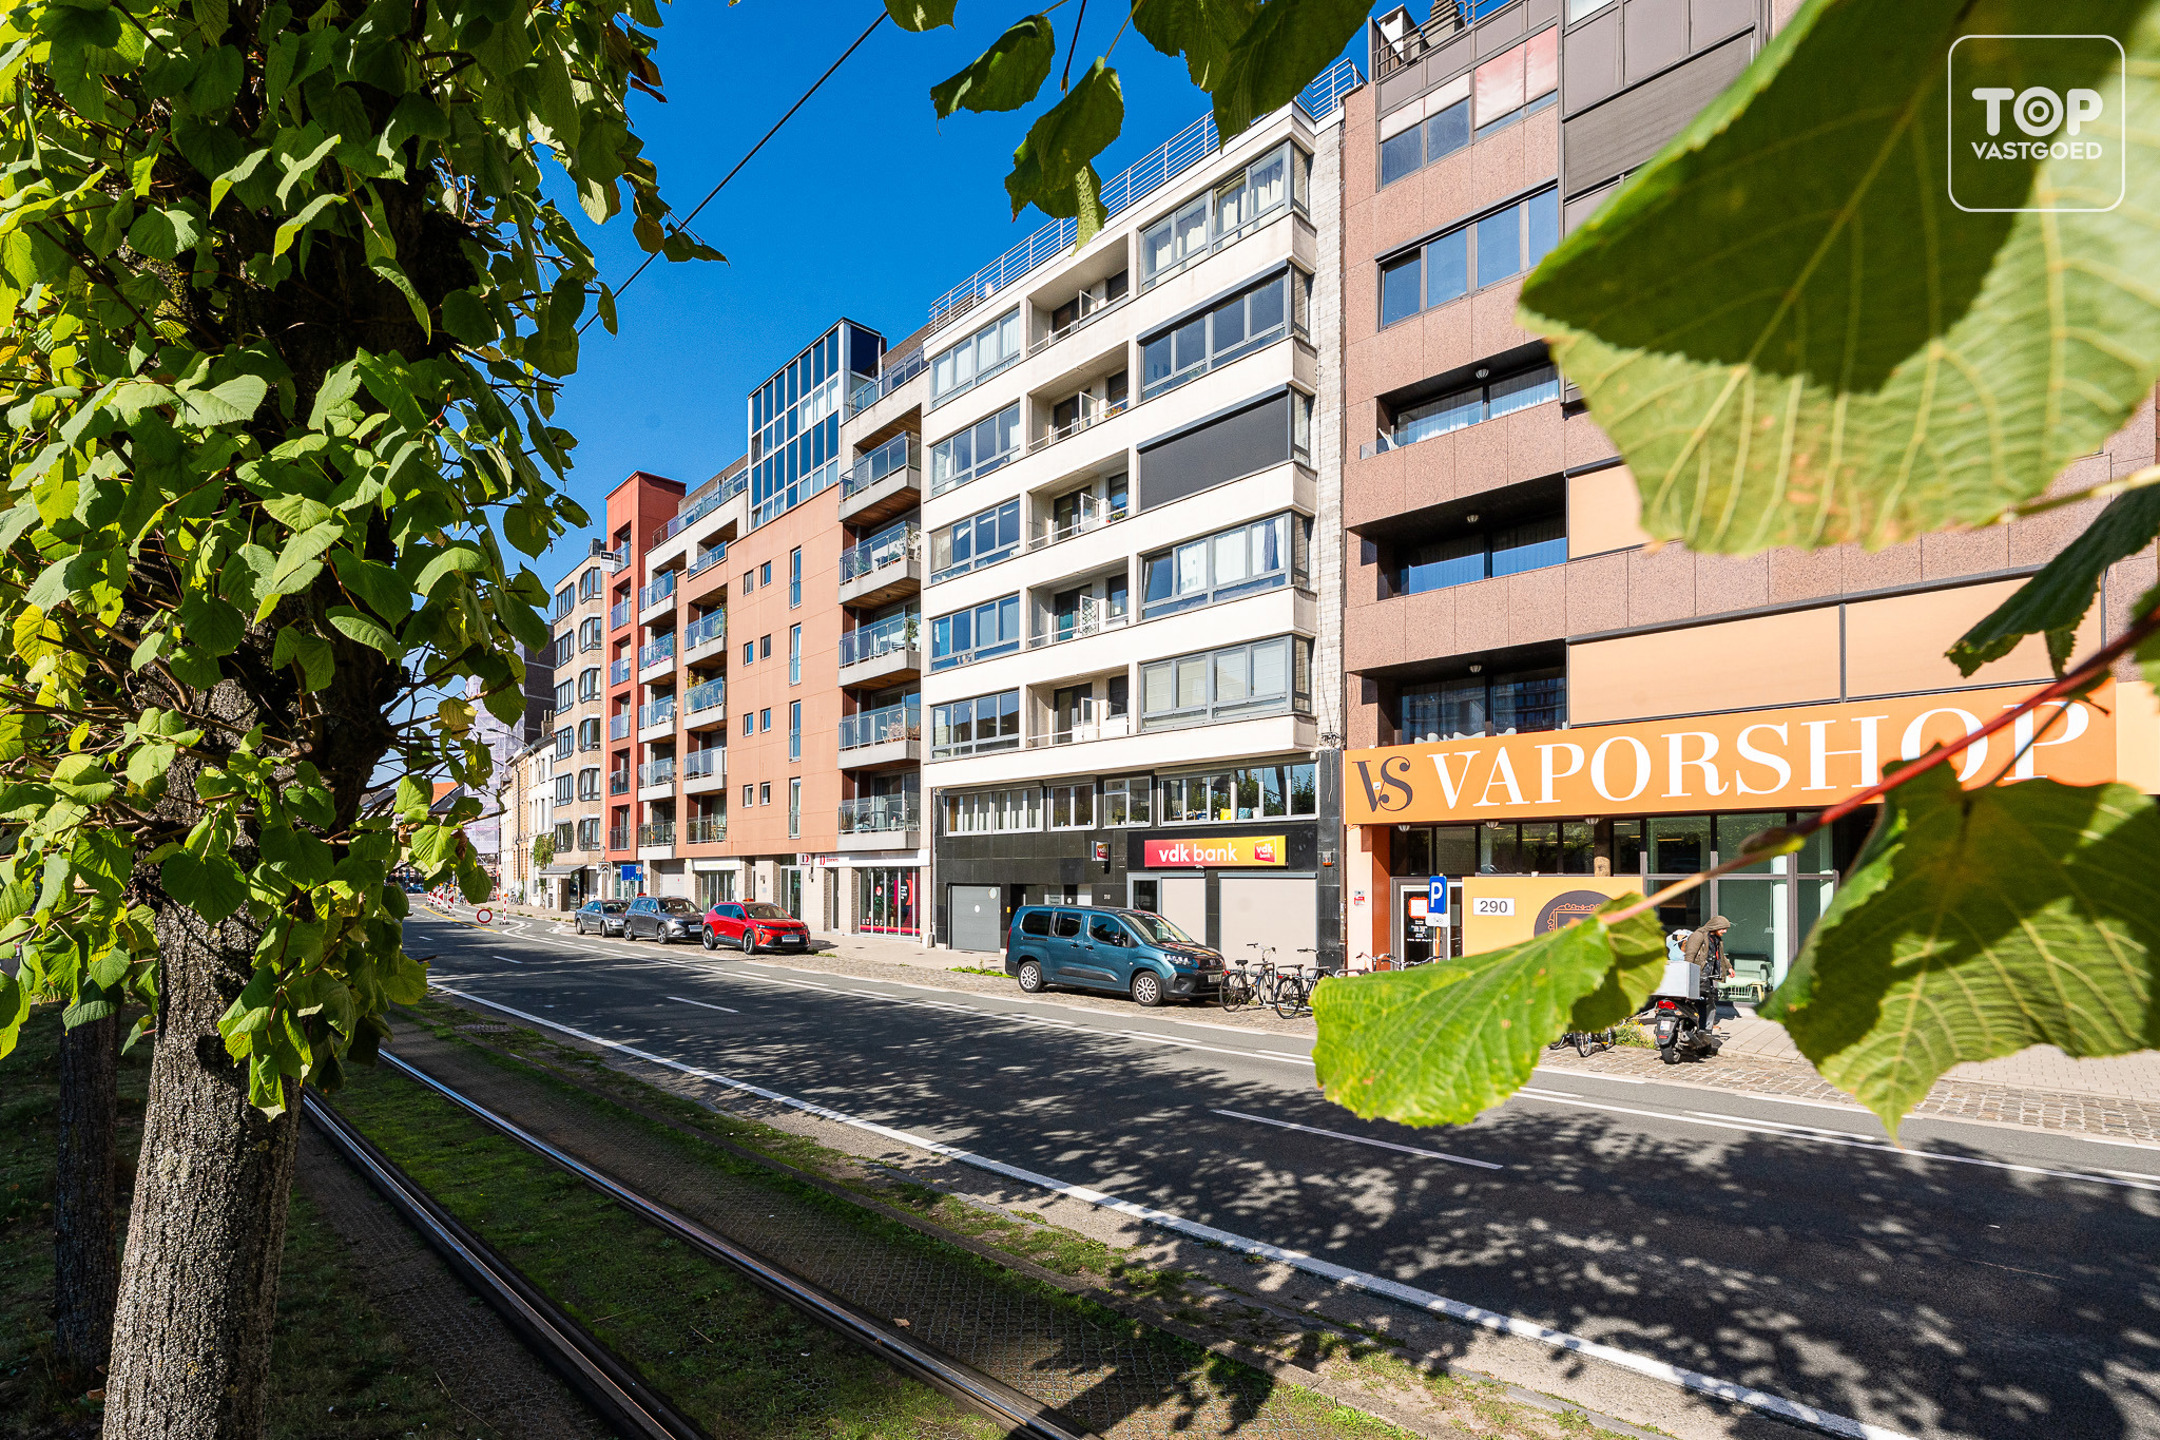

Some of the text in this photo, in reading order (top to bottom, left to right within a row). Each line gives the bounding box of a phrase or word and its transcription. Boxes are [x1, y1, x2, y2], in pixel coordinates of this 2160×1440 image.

[1427, 700, 2090, 810] VAPORSHOP
[1351, 755, 1413, 812] VS
[1158, 842, 1238, 862] vdk bank
[1256, 843, 1274, 853] vdk
[1430, 881, 1444, 908] P
[1479, 900, 1508, 913] 290
